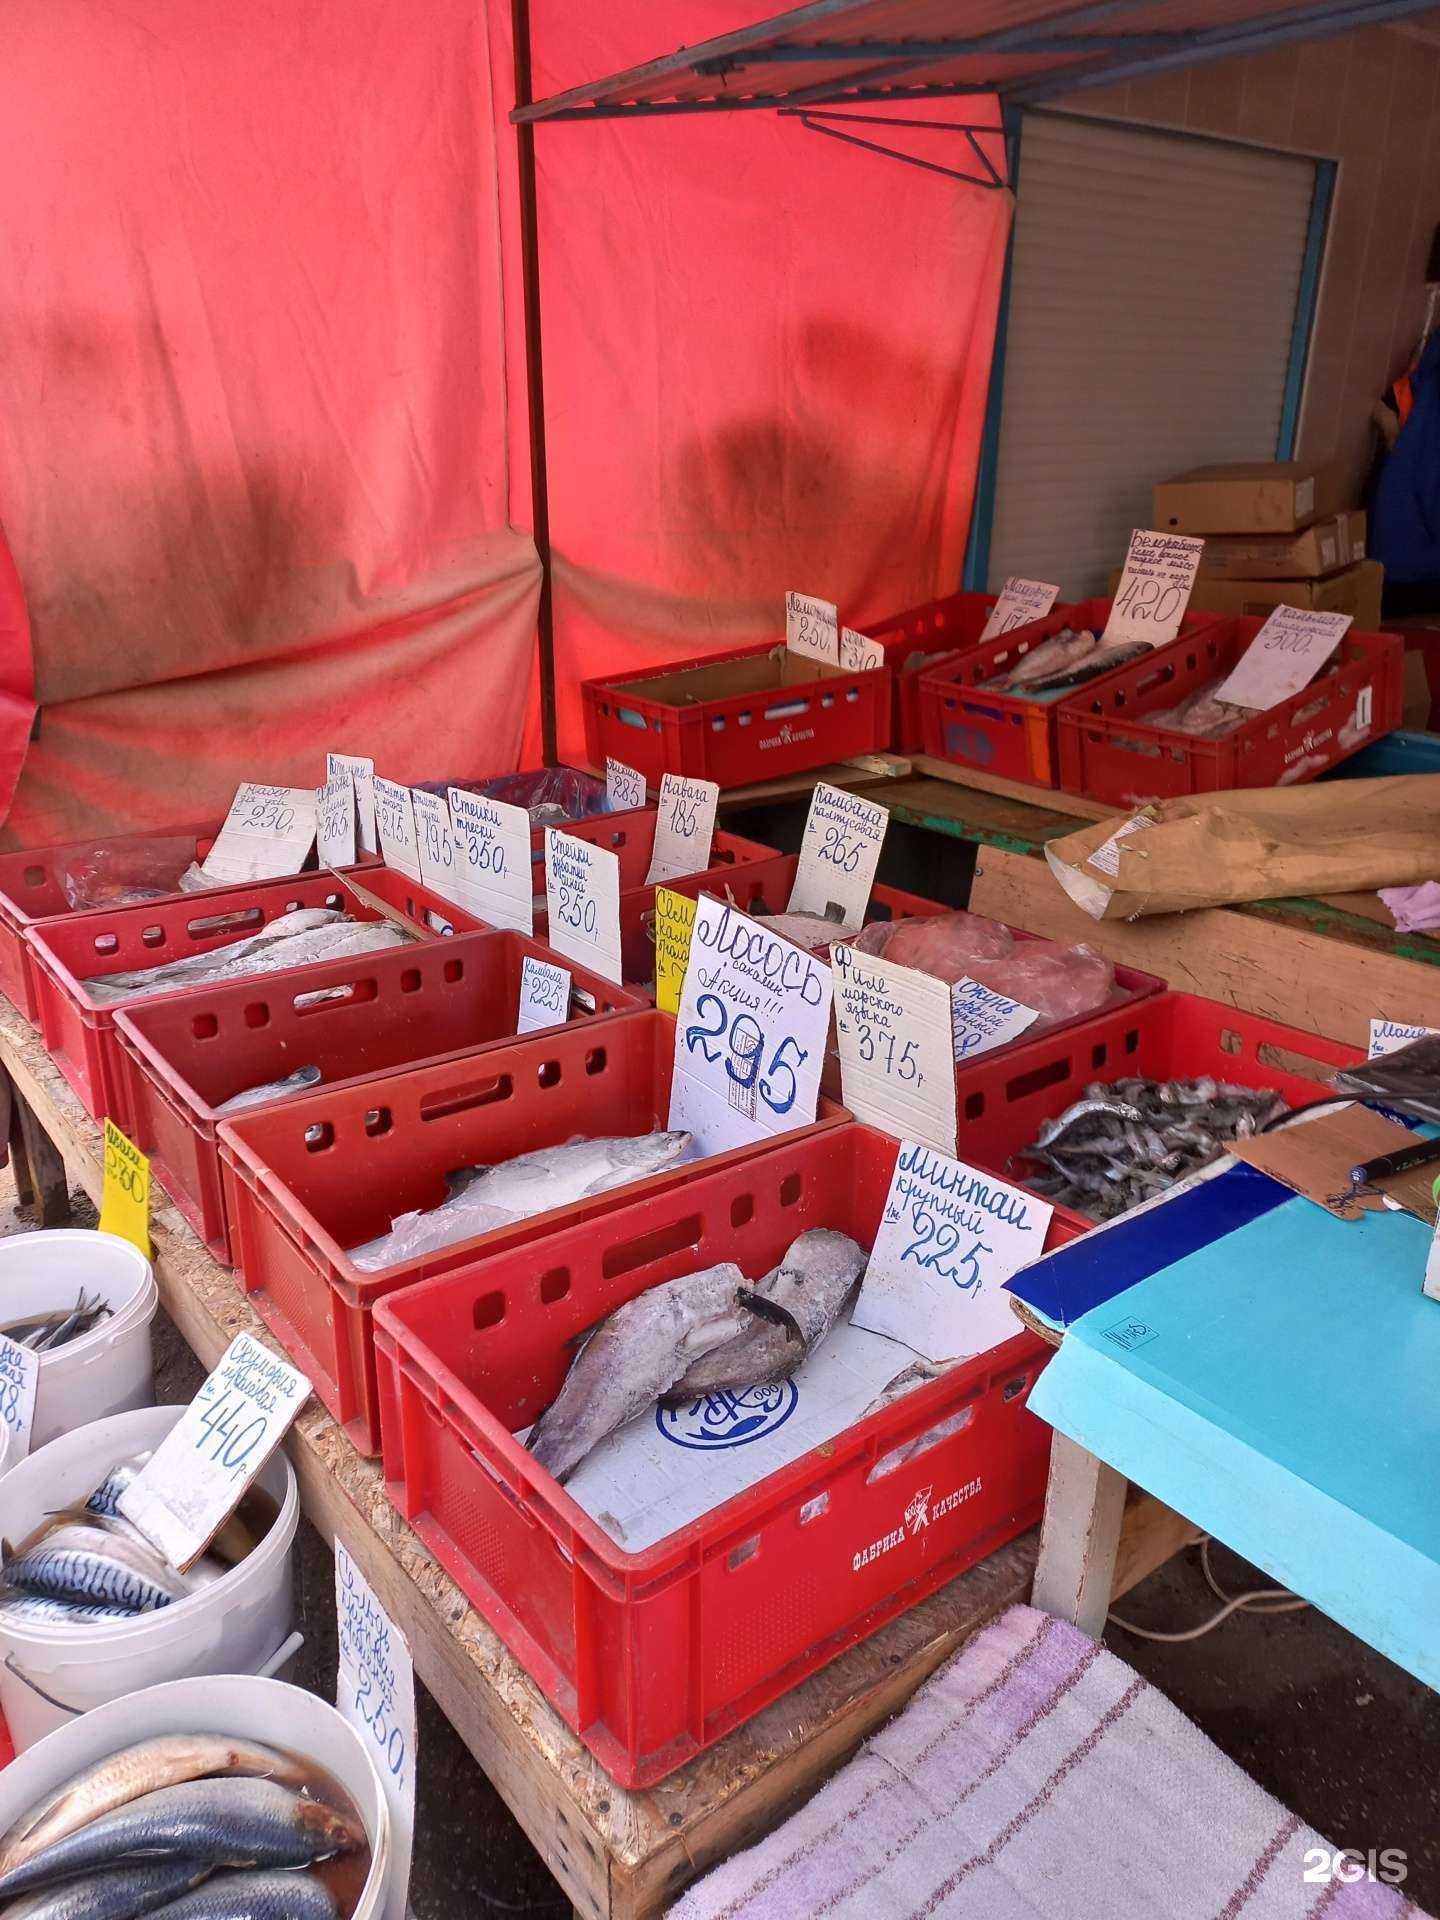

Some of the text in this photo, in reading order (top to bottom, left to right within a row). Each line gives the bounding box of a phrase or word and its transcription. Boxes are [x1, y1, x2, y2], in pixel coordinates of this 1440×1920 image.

[1116, 576, 1182, 623] 420
[451, 791, 502, 826] Стейки
[612, 775, 641, 807] 285
[662, 775, 708, 803] Навага
[815, 784, 886, 829] Камбала
[241, 804, 295, 831] 230
[323, 807, 347, 842] 365
[381, 806, 404, 843] 215
[456, 816, 496, 840] трески
[670, 799, 701, 837] 185
[424, 818, 454, 867] 195
[468, 836, 505, 874] 350
[550, 830, 593, 867] Стейки
[817, 826, 868, 873] 265
[557, 886, 597, 934] 250
[697, 906, 824, 1007] Лосось
[834, 945, 890, 995] Филе
[529, 976, 563, 1011] 225
[841, 987, 904, 1017] морского
[845, 1001, 893, 1029] языка
[959, 981, 1022, 1016] Окунь
[685, 992, 809, 1115] 295
[857, 1023, 921, 1081] 375
[896, 1175, 985, 1236] крупный
[898, 1145, 1033, 1231] Минтай
[900, 1209, 994, 1290] 225
[229, 1337, 297, 1399] Скумбрия
[195, 1388, 269, 1469] 440
[852, 1526, 906, 1573] ФАБРИКА
[932, 1476, 983, 1521] КАЧЕСТВА
[356, 1661, 405, 1776] 250
